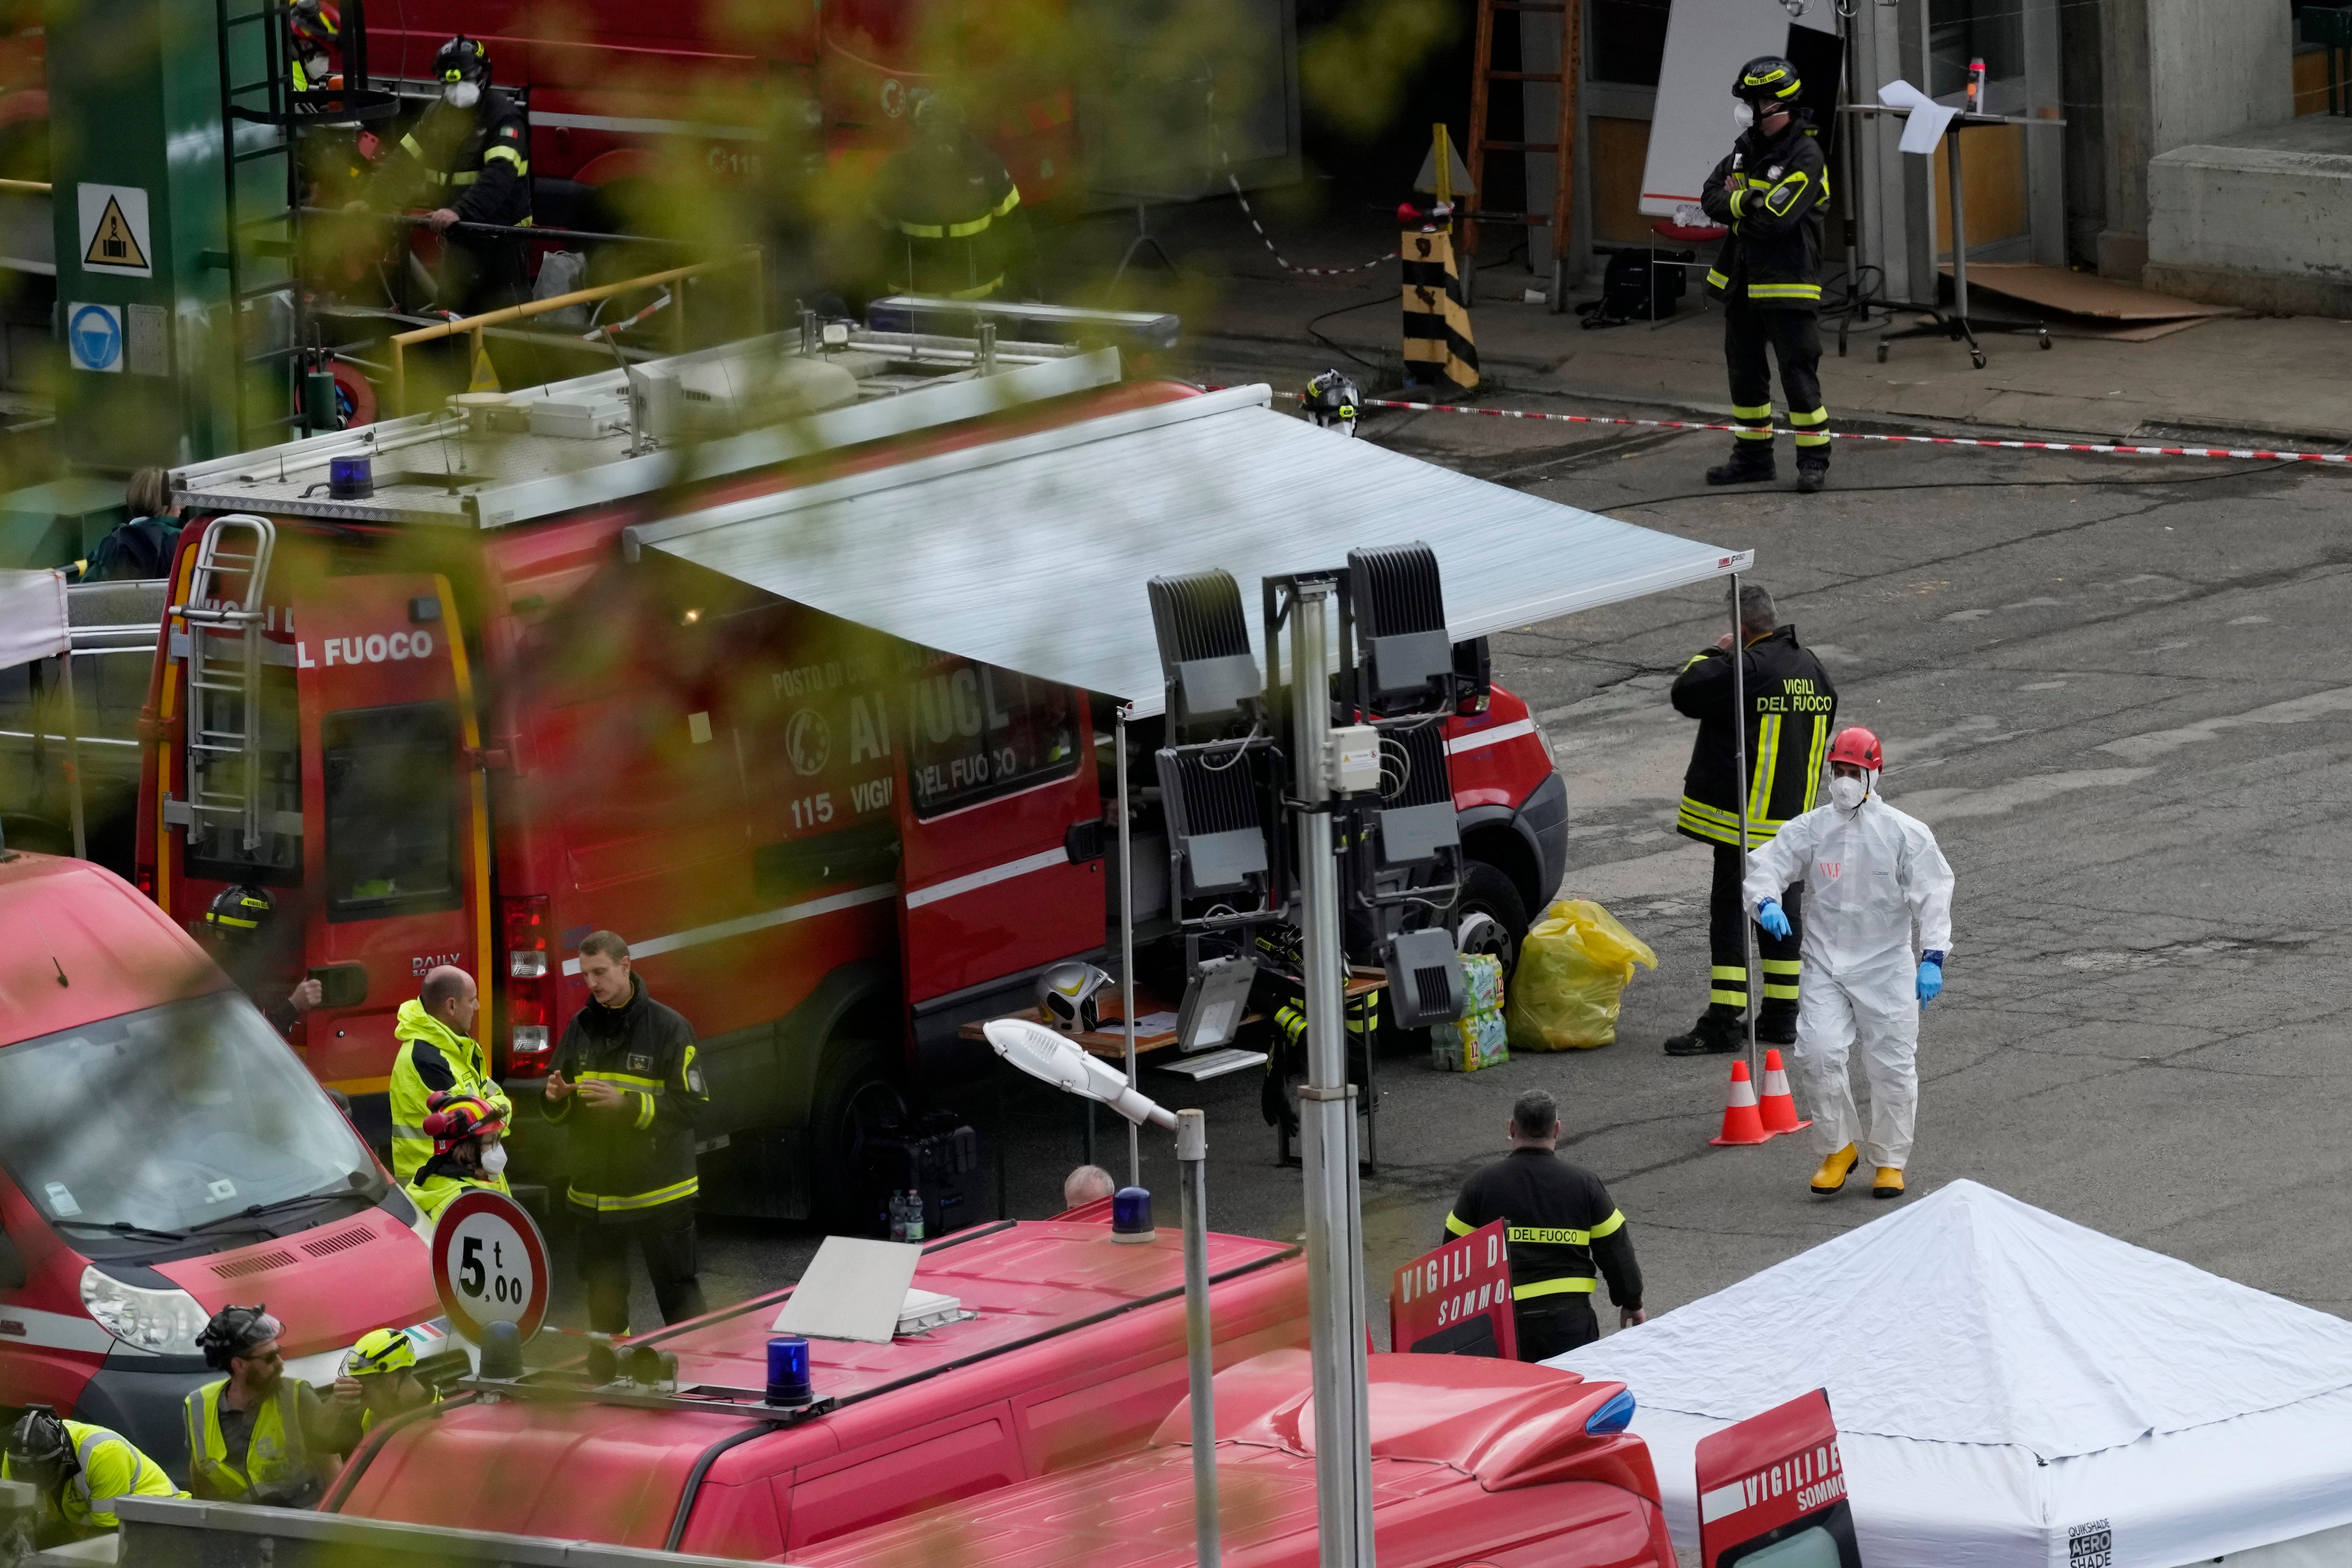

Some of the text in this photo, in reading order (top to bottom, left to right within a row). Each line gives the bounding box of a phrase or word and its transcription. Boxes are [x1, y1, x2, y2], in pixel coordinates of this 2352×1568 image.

[324, 630, 433, 666] FUOCO
[772, 665, 822, 700] POSTO
[1783, 679, 1814, 695] VIGILI
[1757, 696, 1832, 712] DEL FUOCO
[791, 793, 834, 828] 115
[412, 952, 460, 969] DAILY
[1496, 976, 1504, 994] 12
[1470, 1041, 1479, 1058] 12
[1514, 1229, 1535, 1240] DEL
[1539, 1230, 1577, 1242] FUOCO
[1402, 1245, 1470, 1304] VIGILI
[1746, 1452, 1812, 1507] VIGILI
[2068, 1518, 2111, 1538] QUIKSHADE
[2071, 1532, 2111, 1557] AERO
